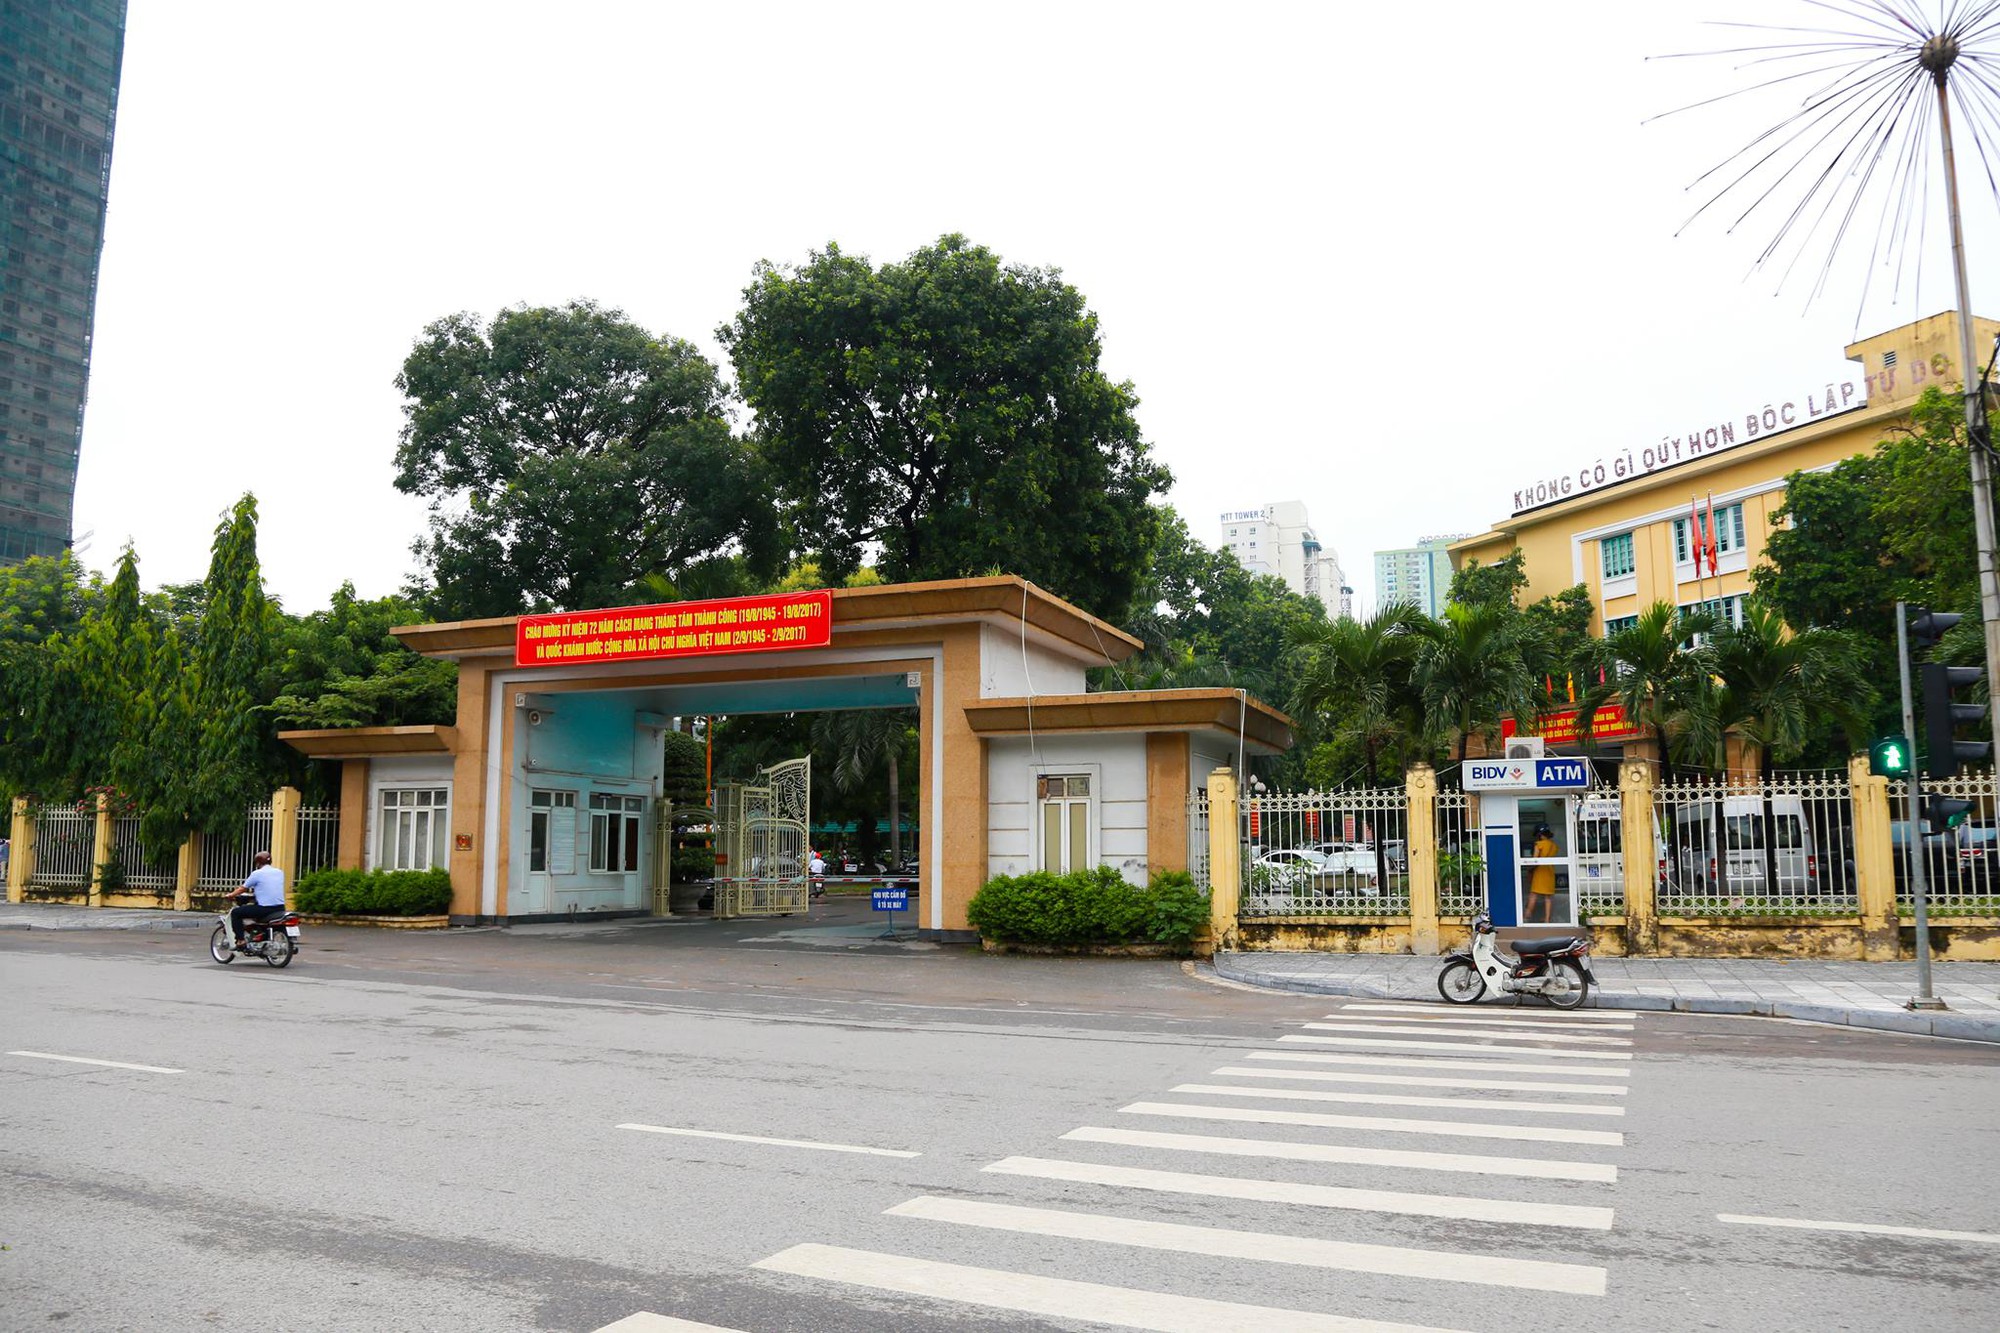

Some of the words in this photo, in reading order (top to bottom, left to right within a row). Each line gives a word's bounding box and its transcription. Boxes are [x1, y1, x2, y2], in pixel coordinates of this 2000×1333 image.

[1514, 475, 1572, 509] KHÔNG
[1580, 458, 1606, 488] CÓ
[1689, 421, 1735, 455] HƠN
[1234, 510, 1259, 520] TOWER
[1260, 509, 1265, 518] 2
[525, 623, 541, 639] CHÀO
[543, 622, 561, 638] MỪNG
[562, 618, 571, 636] KỶ
[571, 620, 588, 638] NIỆM
[589, 622, 598, 634] 72
[598, 618, 613, 634] NĂM
[615, 616, 632, 632] CÁCH
[633, 616, 653, 633] MẠNG
[655, 612, 676, 629] THÁNG
[678, 611, 693, 627] TÁM
[694, 609, 717, 626] THÀNH
[718, 607, 738, 625] CÔNG
[739, 606, 776, 624] (19/8/1945
[783, 602, 821, 619] 19/8/2017)
[536, 643, 545, 658] VÀ
[546, 640, 562, 659] QUỐC
[563, 641, 585, 657] KHÁNH
[585, 637, 603, 655] NƯỚC
[604, 637, 622, 656] CỘNG
[638, 635, 647, 651] XÃ
[648, 634, 660, 653] HỘI
[661, 630, 675, 650] CHỦ
[676, 631, 697, 649] NGHĨA
[698, 630, 713, 650] VIỆT
[714, 631, 731, 646] NAM
[732, 629, 766, 646] (2/9/1945
[771, 625, 806, 642] 2/9/2017)
[1472, 766, 1507, 779] BIDV
[1541, 765, 1582, 781] ATM
